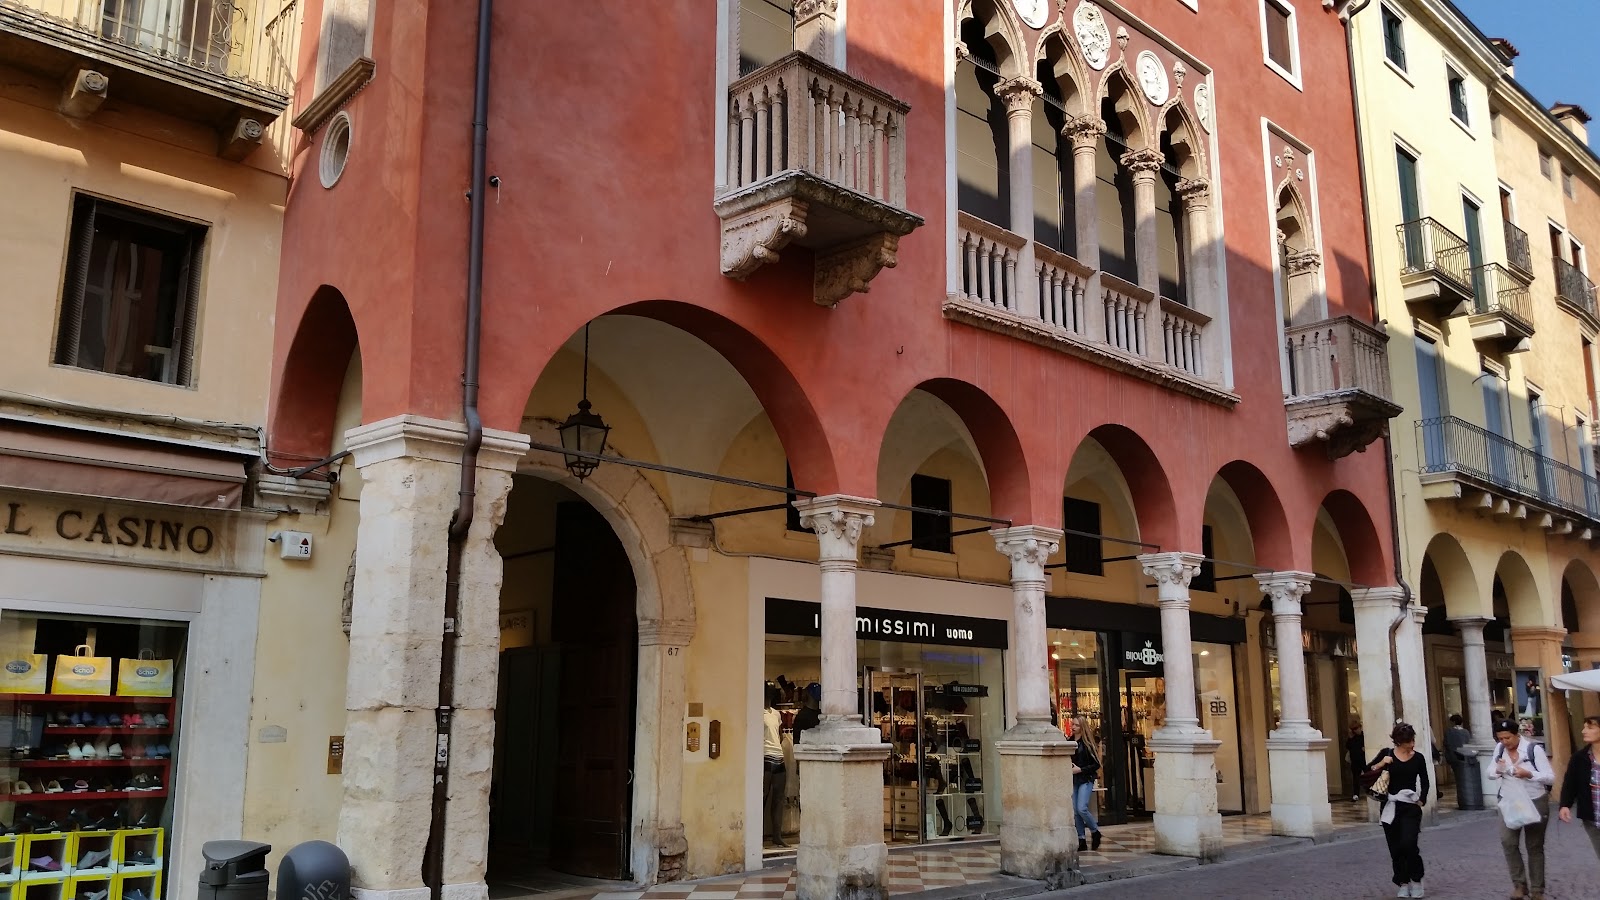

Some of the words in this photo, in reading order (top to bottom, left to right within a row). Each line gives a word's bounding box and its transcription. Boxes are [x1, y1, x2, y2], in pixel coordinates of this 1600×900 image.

[55, 510, 215, 555] CASINO
[945, 627, 974, 640] uomo
[667, 647, 680, 657] 67
[1125, 650, 1143, 662] BIJOU
[74, 665, 95, 674] Scholl
[137, 668, 158, 676] Scholl
